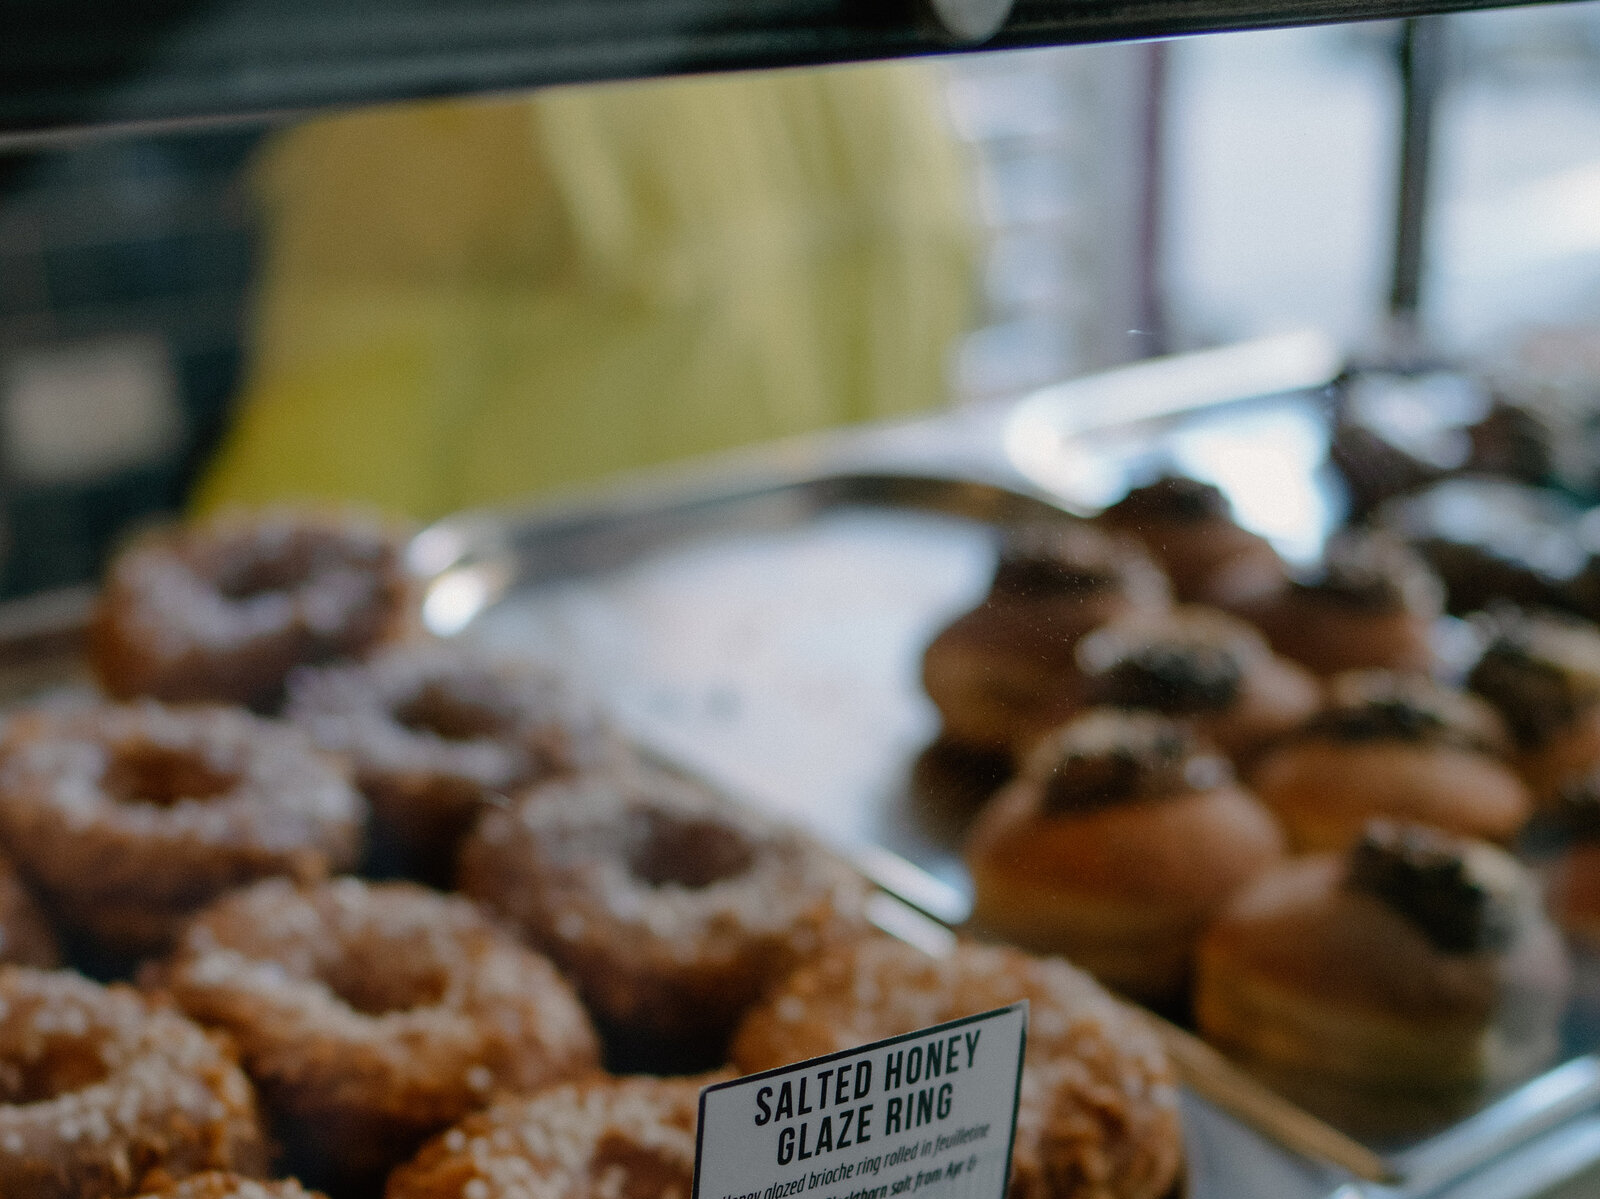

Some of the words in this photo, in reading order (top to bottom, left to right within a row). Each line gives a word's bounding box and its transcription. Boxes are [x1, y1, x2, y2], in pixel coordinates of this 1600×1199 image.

[754, 1059, 873, 1127] SALTED
[884, 1029, 982, 1092] HONEY
[776, 1104, 874, 1167] GLAZE
[885, 1082, 954, 1137] RING
[807, 1162, 855, 1190] brioche
[856, 1155, 882, 1176] ring
[883, 1141, 920, 1168] rolled
[920, 1138, 934, 1157] in
[889, 1174, 913, 1197] salt
[912, 1166, 943, 1194] from
